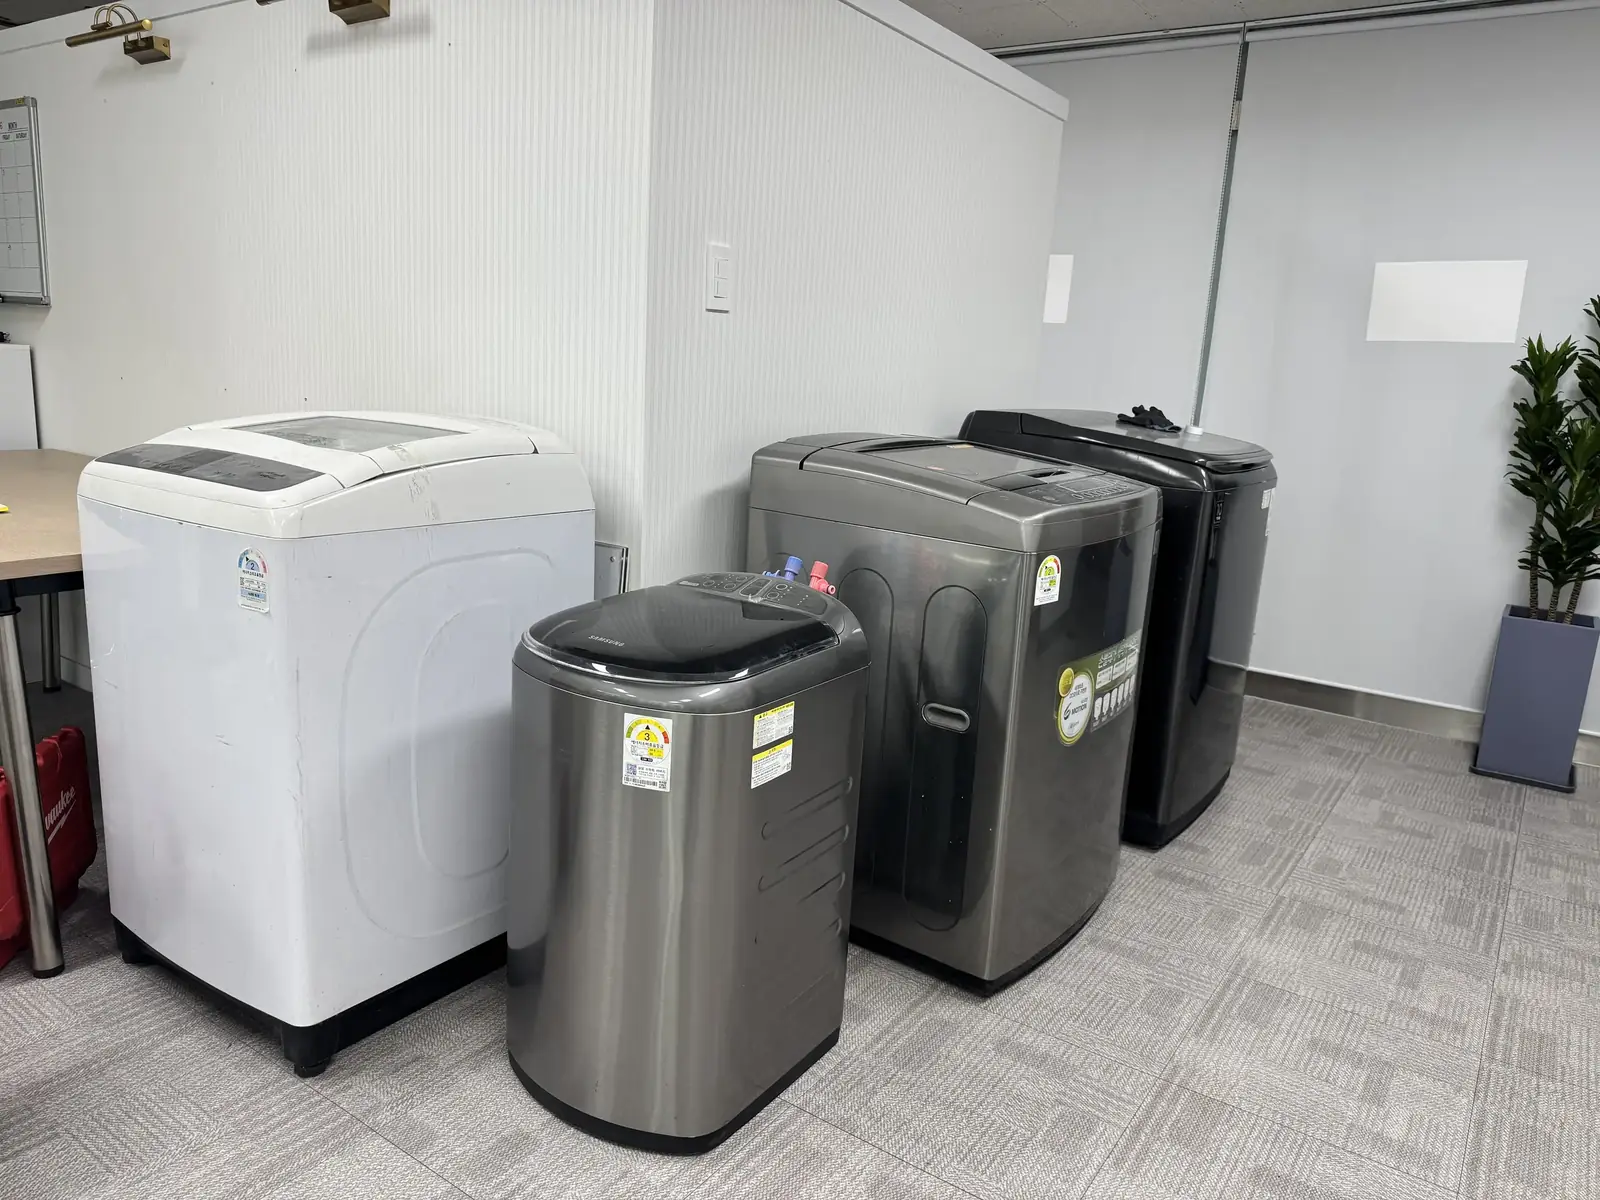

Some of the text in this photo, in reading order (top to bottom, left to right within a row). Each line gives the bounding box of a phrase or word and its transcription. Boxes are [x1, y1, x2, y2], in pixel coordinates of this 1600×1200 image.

[250, 562, 255, 571] 2
[588, 635, 625, 647] SAMSUNG
[644, 732, 650, 741] 3
